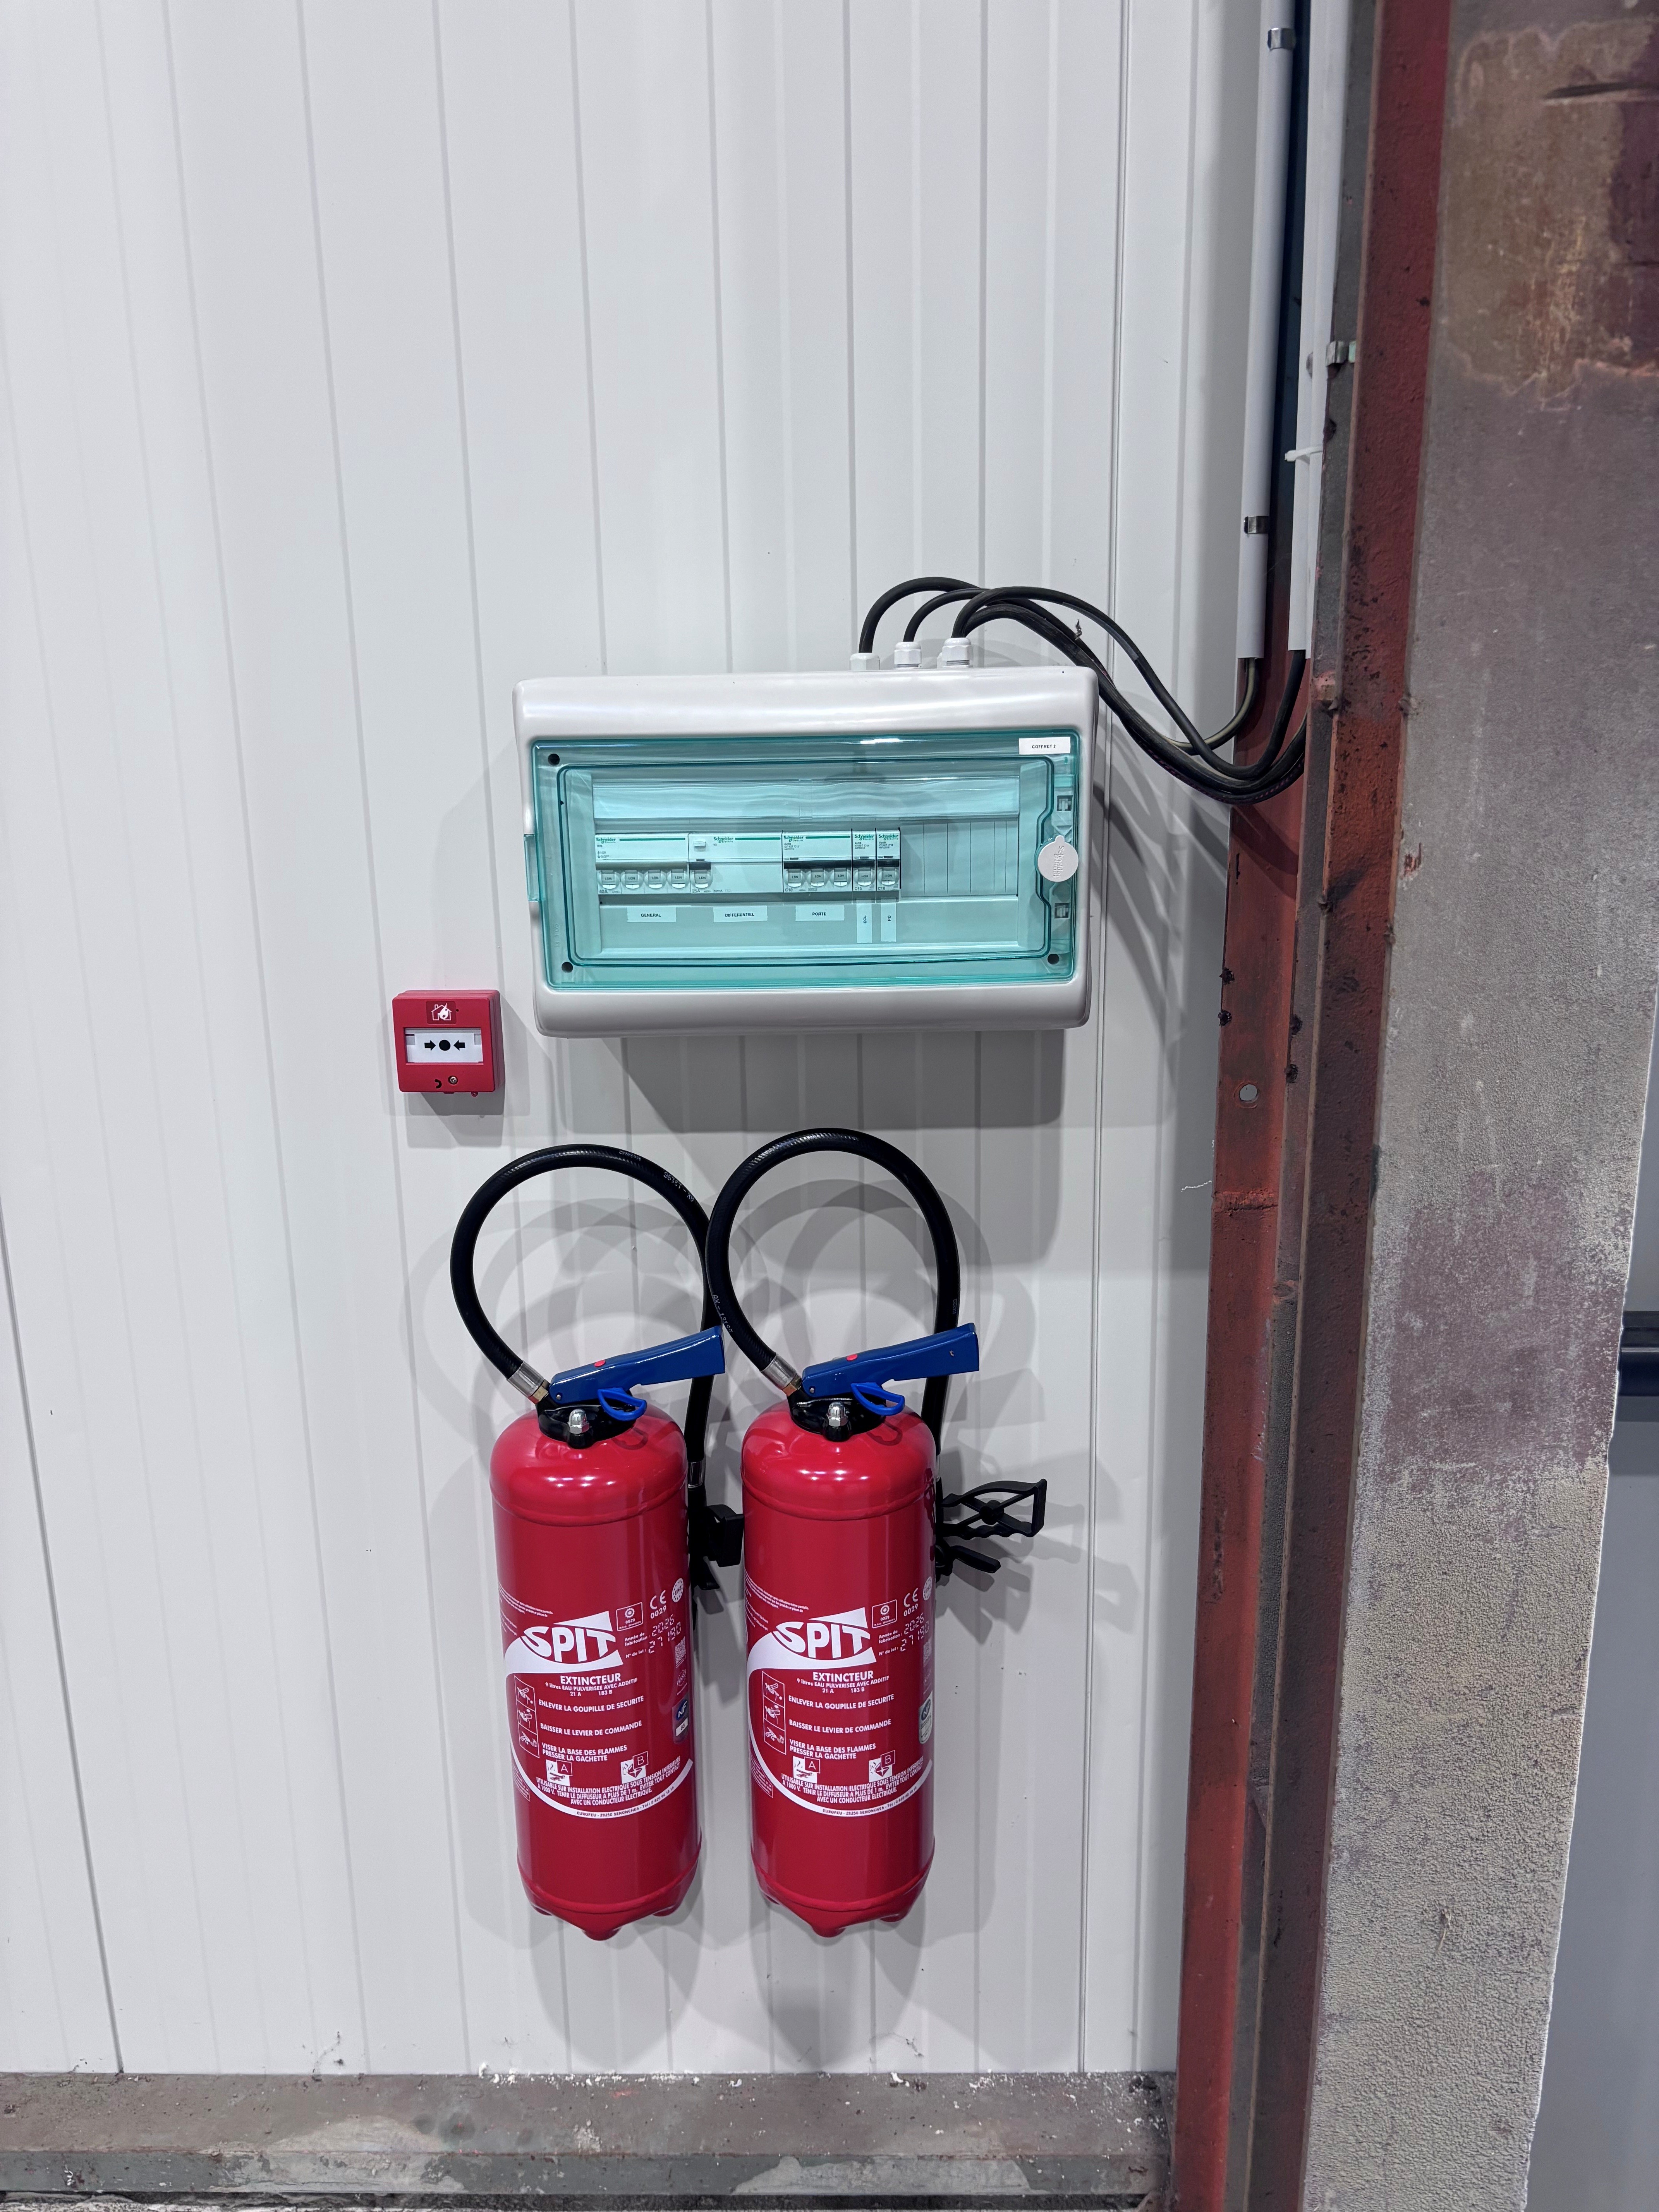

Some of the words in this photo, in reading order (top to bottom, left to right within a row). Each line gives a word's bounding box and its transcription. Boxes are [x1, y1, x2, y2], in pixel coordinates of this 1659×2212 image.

[650, 1590, 666, 1609] CE
[903, 1588, 918, 1607] CE
[650, 1605, 666, 1619] 0029
[904, 1603, 918, 1616] 0029
[521, 1626, 616, 1662] SPIT
[773, 1621, 870, 1658] SPIT
[560, 1673, 621, 1685] EXTINCTEUR
[618, 1678, 638, 1686] ADDITIF
[813, 1670, 873, 1682] EXTINCTEUR
[871, 1676, 889, 1685] ADDITIF
[539, 1699, 562, 1711] ENLEVER
[573, 1704, 605, 1712] GOUPILLE
[617, 1696, 644, 1709] SECURITE
[788, 1695, 813, 1707] ENLEVER
[868, 1693, 894, 1707] SECURITE
[678, 1701, 687, 1718] NF
[540, 1723, 562, 1734] BAISSER
[605, 1721, 642, 1735] COMMANDE
[789, 1719, 812, 1731] BAISSER
[855, 1719, 891, 1732] COMMANDE
[542, 1742, 557, 1752] VISER
[598, 1745, 627, 1755] FLAMMES
[789, 1738, 805, 1749] VISER
[847, 1743, 876, 1753] FLAMMES
[790, 1745, 814, 1757] PRESSER
[543, 1749, 565, 1760] PRESSER
[637, 1756, 644, 1765] B
[885, 1755, 891, 1764] B
[561, 1764, 568, 1773] A
[808, 1761, 816, 1770] A
[536, 1777, 557, 1790] UTILISABLE
[602, 1783, 629, 1793] ELECTRIQUE
[630, 1779, 642, 1788] SOUS
[644, 1771, 661, 1784] TENSION
[640, 1781, 654, 1791] EVITER
[655, 1774, 665, 1784] TOUT
[665, 1762, 680, 1778] CONTACT
[781, 1773, 804, 1786] UTILISABLE
[849, 1782, 876, 1791] ELECTRIQUE
[877, 1778, 889, 1786] SOUS
[890, 1769, 907, 1783] TENSION
[787, 1781, 796, 1790] 1000
[803, 1787, 816, 1795] TENIR
[886, 1780, 900, 1790] EVITER
[900, 1774, 909, 1784] TOUT
[592, 1796, 625, 1805] CONDUCTEUR
[625, 1787, 652, 1801] ELECTRIQUE.
[838, 1794, 871, 1803] CONDUCTEUR
[872, 1786, 898, 1800] ELECTRIQUE.
[614, 1807, 639, 1816] SENONCHES
[859, 1806, 884, 1815] SENONCHES
